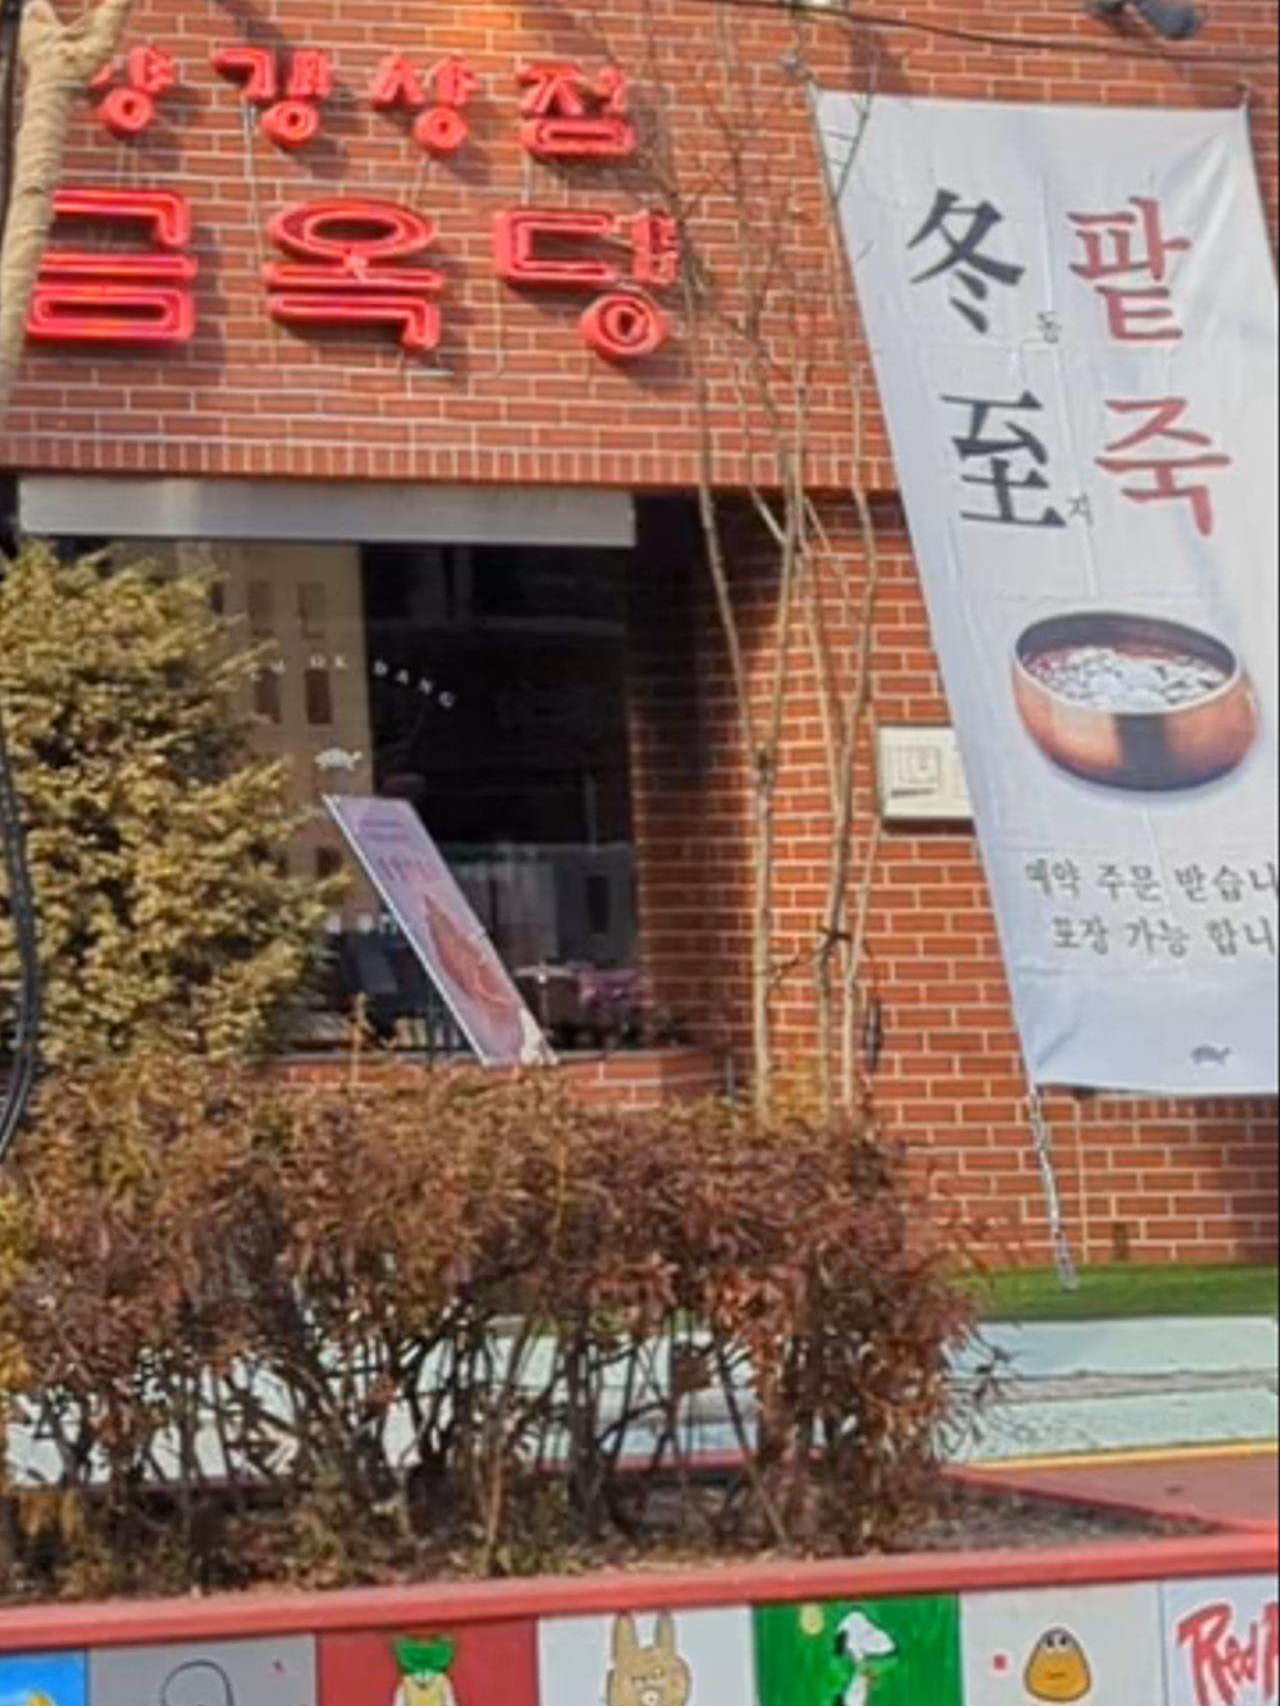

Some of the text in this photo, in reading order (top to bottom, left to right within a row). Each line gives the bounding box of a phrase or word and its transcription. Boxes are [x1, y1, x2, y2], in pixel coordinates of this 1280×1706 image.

[26, 188, 680, 362] 금옥당
[905, 189, 1067, 529] 冬至
[1067, 195, 1232, 537] 팥죽
[1097, 864, 1163, 903] 주문
[1124, 916, 1189, 958] 가능
